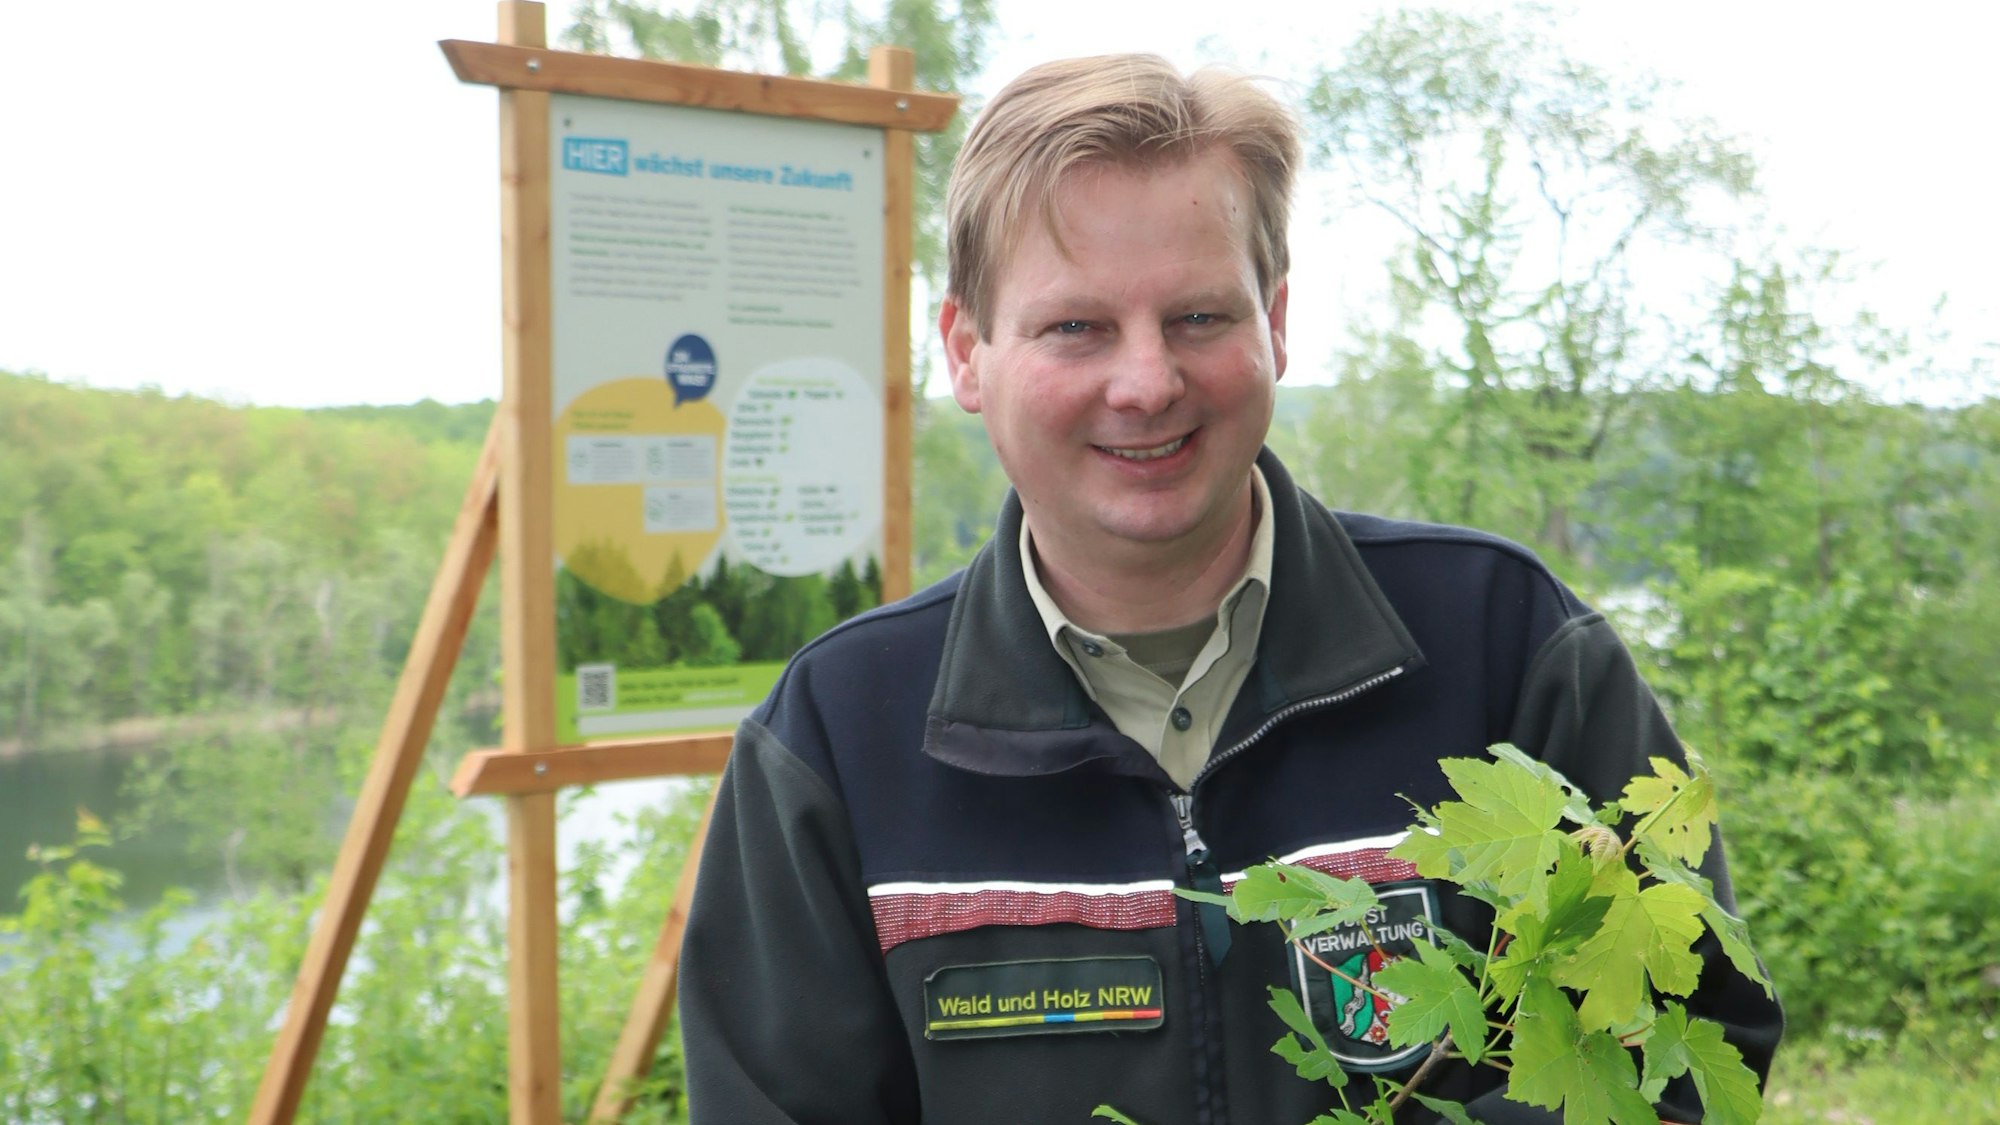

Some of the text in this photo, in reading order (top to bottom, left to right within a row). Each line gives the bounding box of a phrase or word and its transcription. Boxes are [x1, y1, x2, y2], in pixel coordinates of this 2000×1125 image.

[568, 141, 854, 192] HIER wächst unsere Zukunft
[938, 986, 1151, 1017] Wald und Holz NRW
